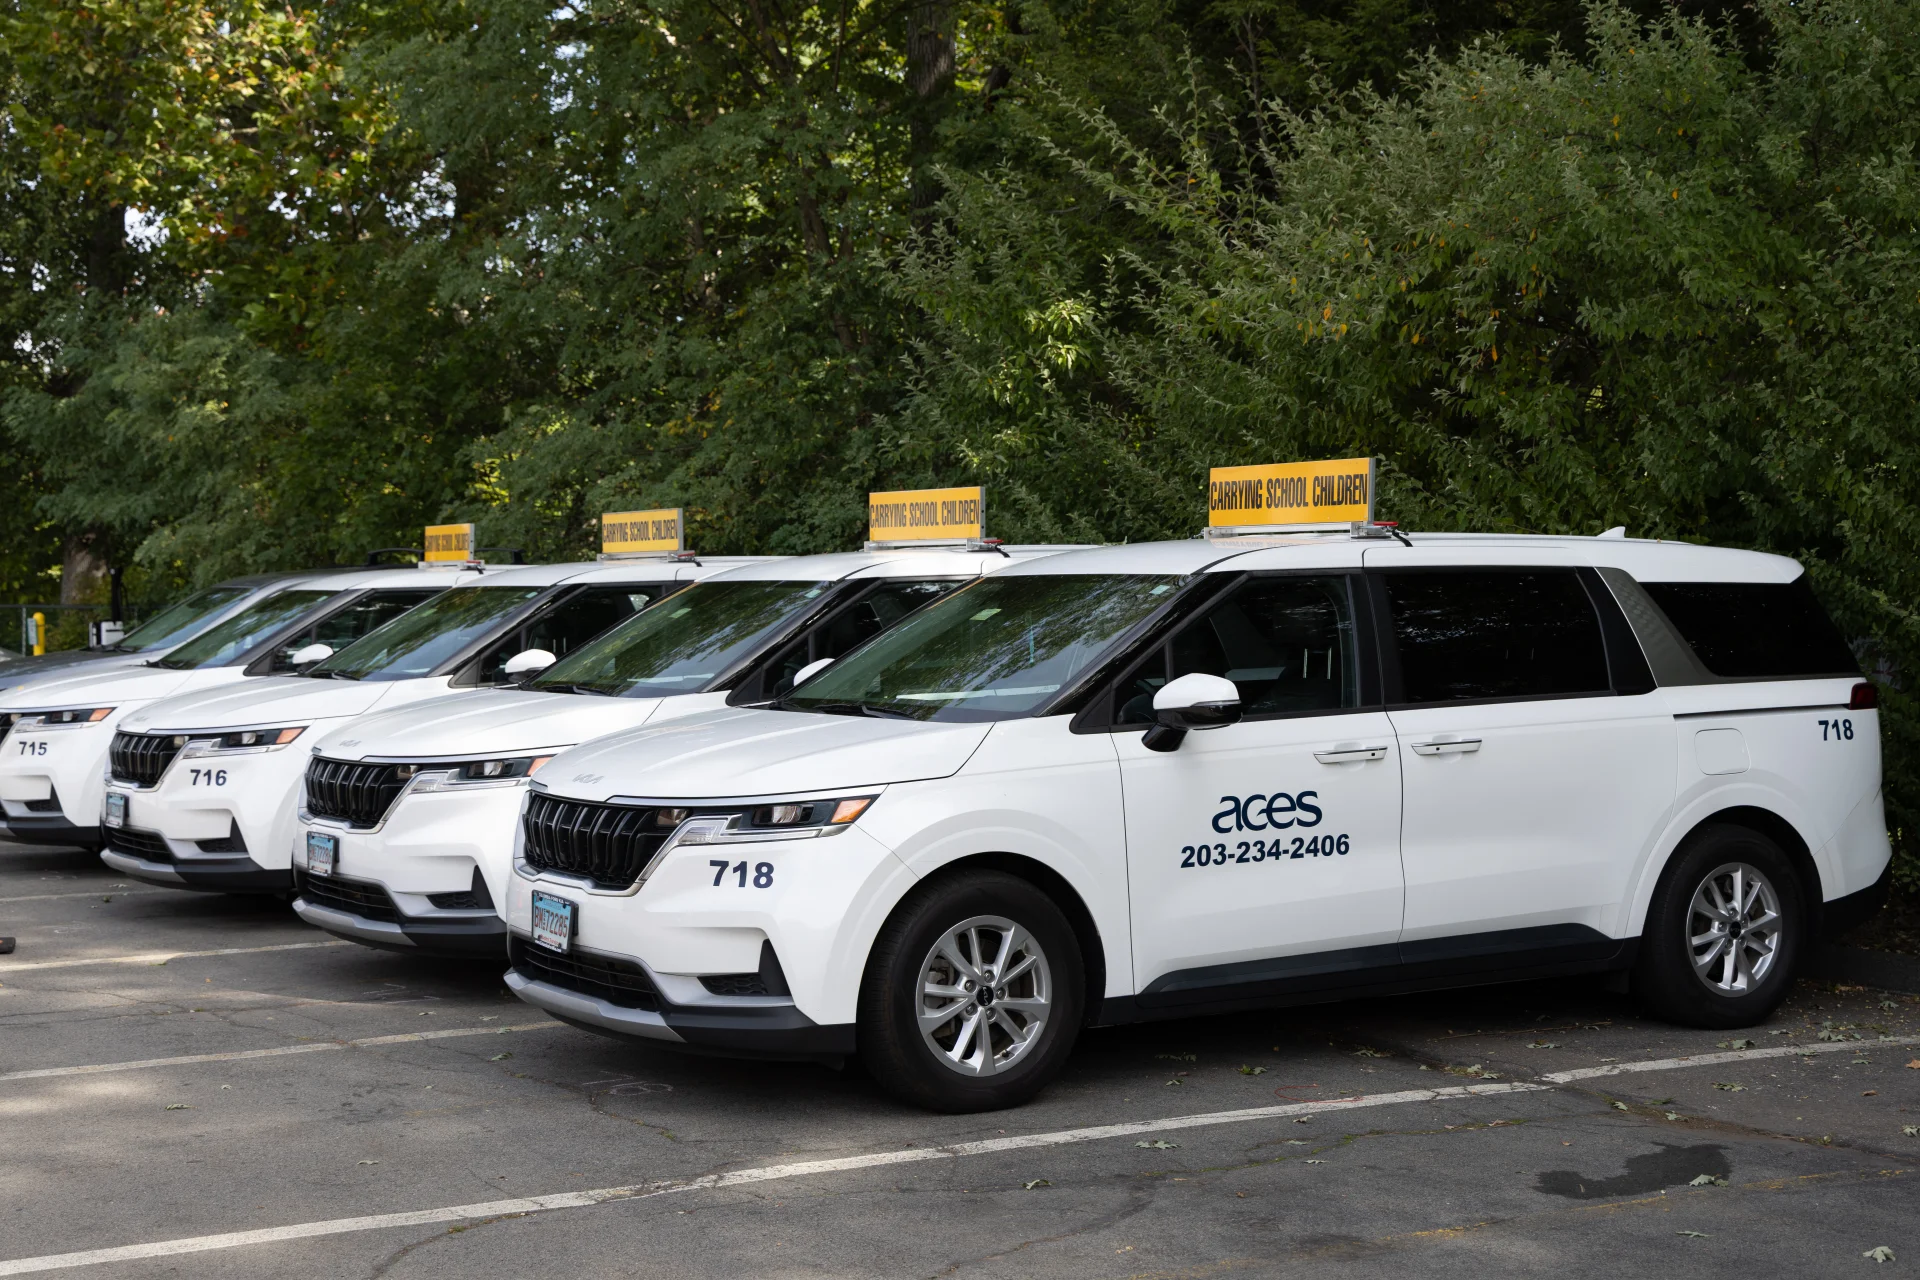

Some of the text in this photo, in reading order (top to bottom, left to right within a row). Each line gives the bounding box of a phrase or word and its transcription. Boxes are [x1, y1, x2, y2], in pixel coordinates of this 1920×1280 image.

[1210, 473, 1368, 511] CARRYING SCHOOL CHILDREN
[870, 499, 980, 528] CARRYING SCHOOL CHILDREN
[630, 520, 650, 542] SCHOOL
[652, 518, 678, 541] CHILDREN
[1818, 718, 1854, 741] 718
[19, 741, 47, 756] 715
[190, 769, 227, 786] 716
[1211, 790, 1323, 834] aces
[1180, 833, 1350, 868] 203-234-2406
[709, 860, 775, 889] 718
